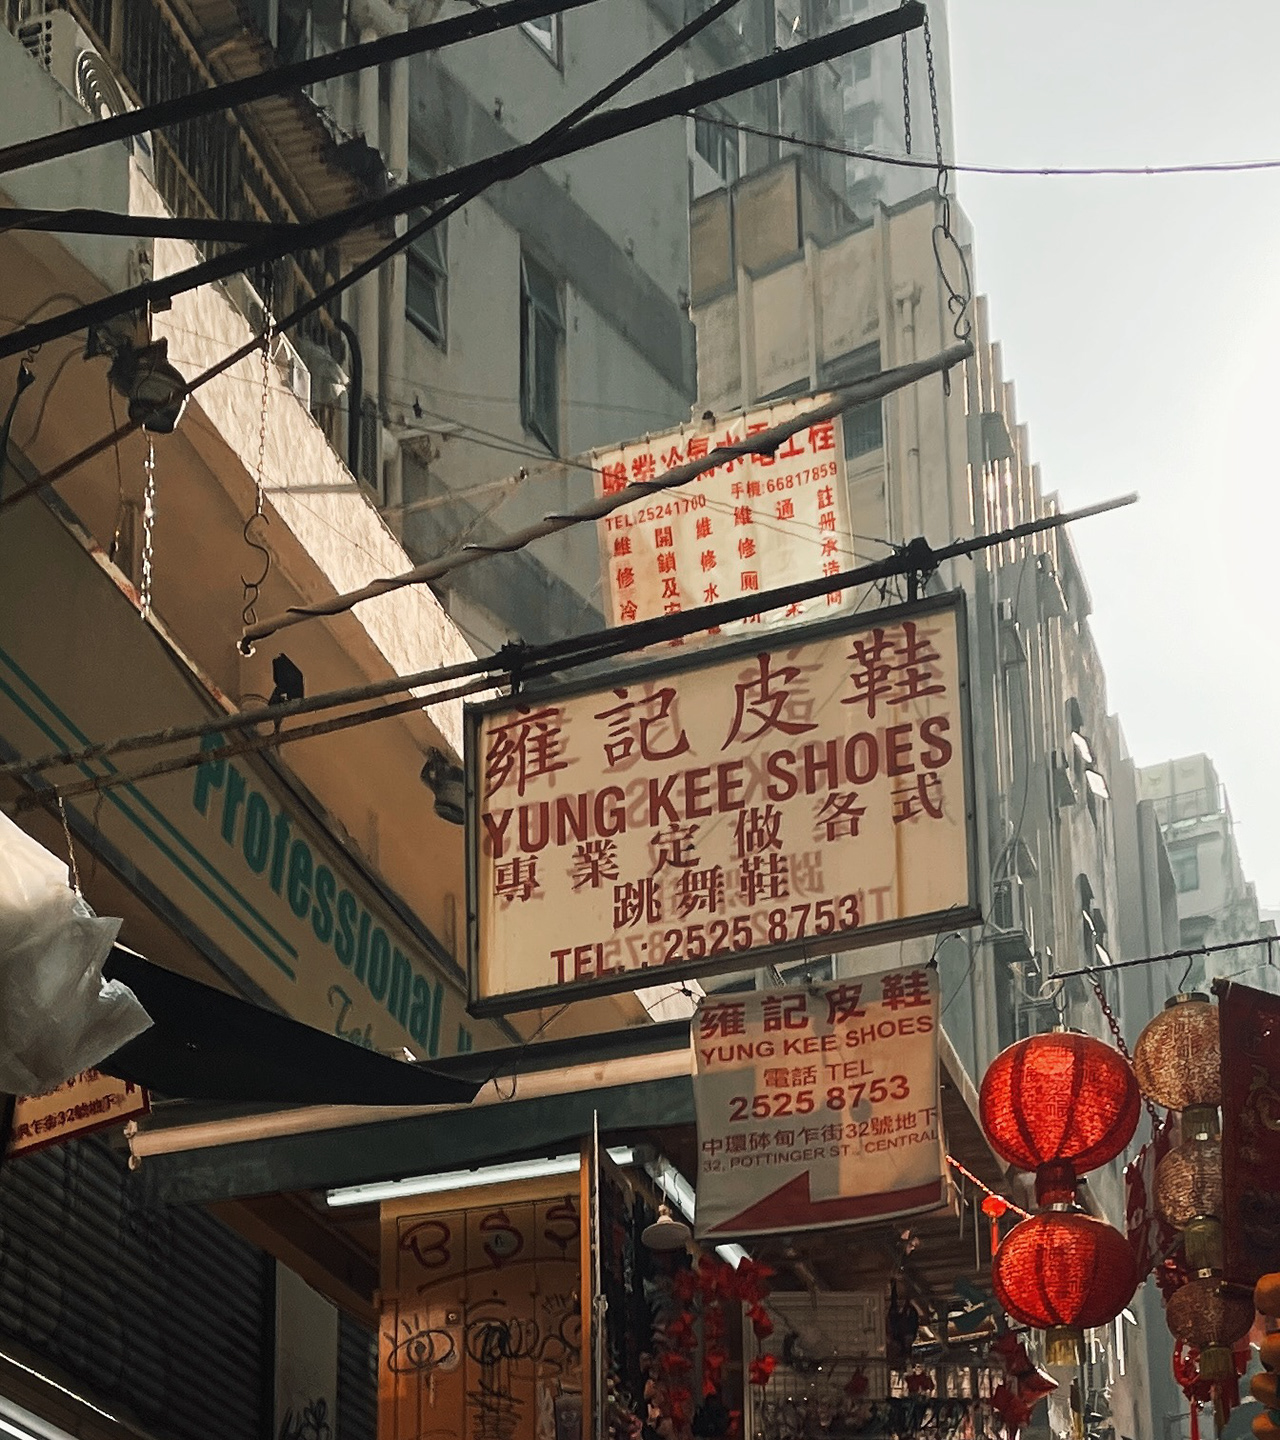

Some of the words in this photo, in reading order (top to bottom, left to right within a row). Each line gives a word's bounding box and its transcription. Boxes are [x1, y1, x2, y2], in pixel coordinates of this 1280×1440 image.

[483, 621, 947, 800] 雍記皮鞋
[482, 787, 627, 859] YUNG
[650, 764, 745, 836] KEE
[768, 717, 953, 800] SHOES
[192, 731, 448, 1058] Professional
[613, 855, 789, 930] 跳舞鞋
[664, 914, 753, 966] 2525
[768, 894, 861, 945] 8753
[699, 970, 932, 1040] 雍記皮鞋
[701, 1040, 775, 1066] YUNG
[784, 1032, 837, 1056] KEE
[846, 1015, 933, 1047] SHOES
[729, 1090, 815, 1122] 2525
[826, 1075, 910, 1111] 8753
[763, 1065, 818, 1088] 電話
[825, 1058, 875, 1082] TEL
[730, 1148, 826, 1169] POTTINGER
[865, 1129, 938, 1154] CENTRAL
